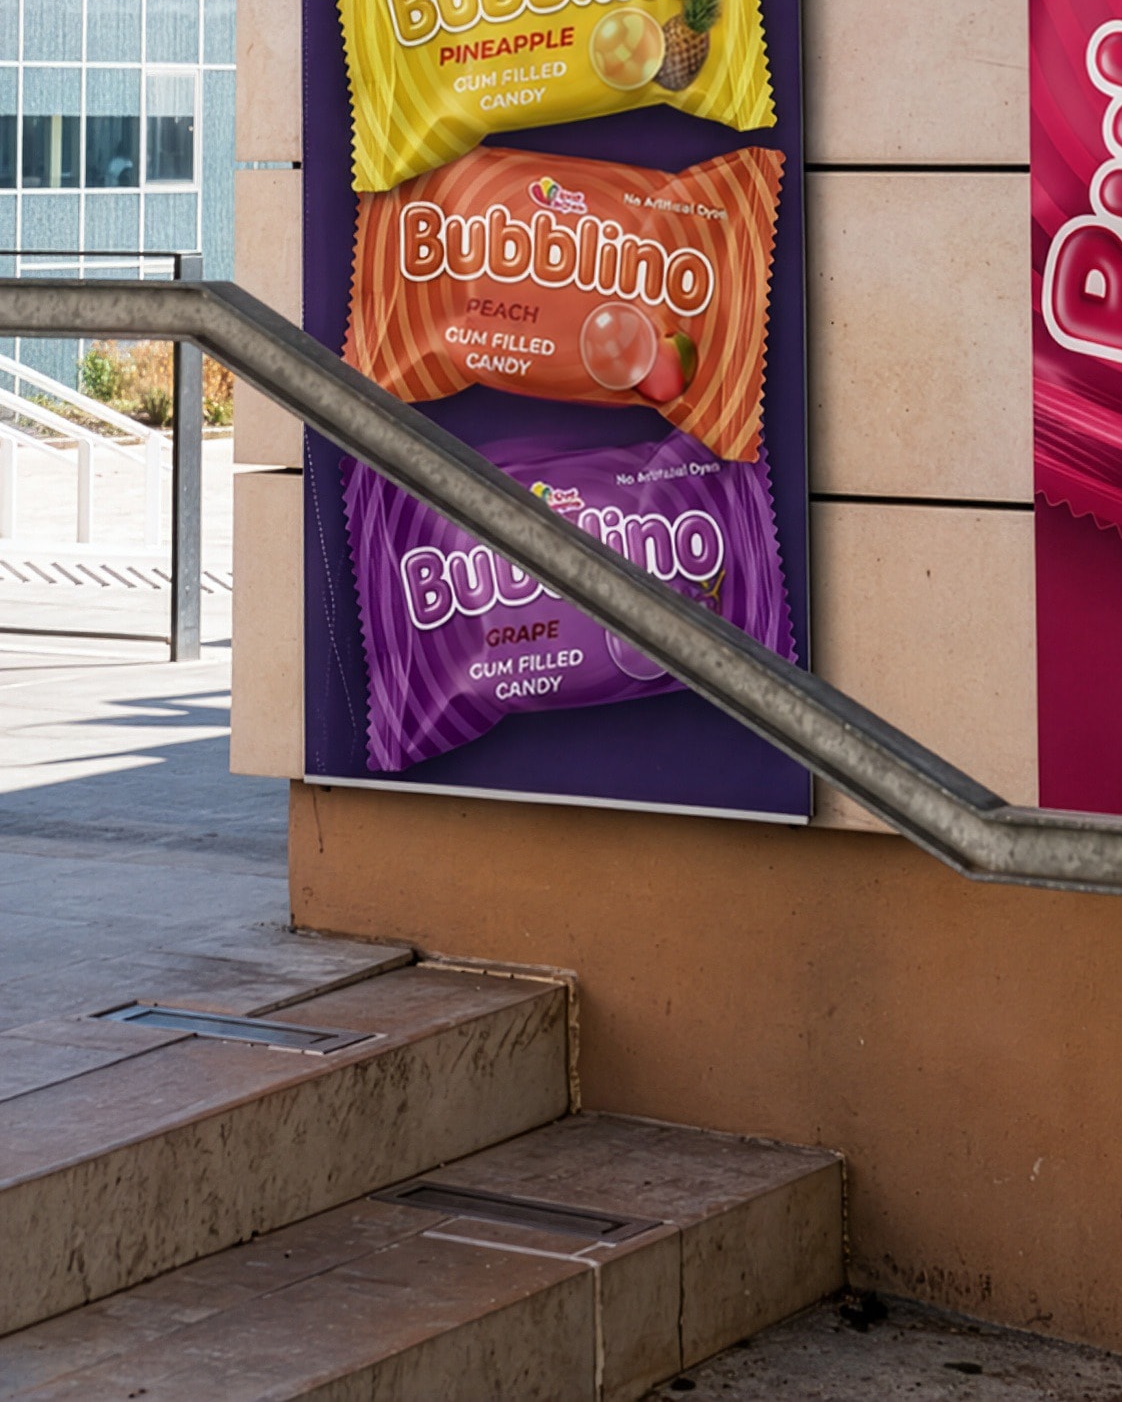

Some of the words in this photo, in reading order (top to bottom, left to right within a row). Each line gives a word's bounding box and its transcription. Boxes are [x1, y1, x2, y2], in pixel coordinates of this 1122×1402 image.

[438, 26, 576, 67] PINEAPPLE
[452, 72, 498, 94] GUM
[498, 60, 568, 86] FILLED
[479, 86, 547, 112] CANDY
[399, 200, 715, 318] Bubblino
[465, 297, 540, 325] PEACH
[444, 325, 491, 346] GUM
[491, 331, 556, 357] FILLED
[465, 352, 533, 377] CANDY
[484, 619, 561, 648] GRAPE
[468, 659, 515, 680] GUM
[517, 648, 585, 675] FILLED
[494, 675, 563, 701] CANDY
